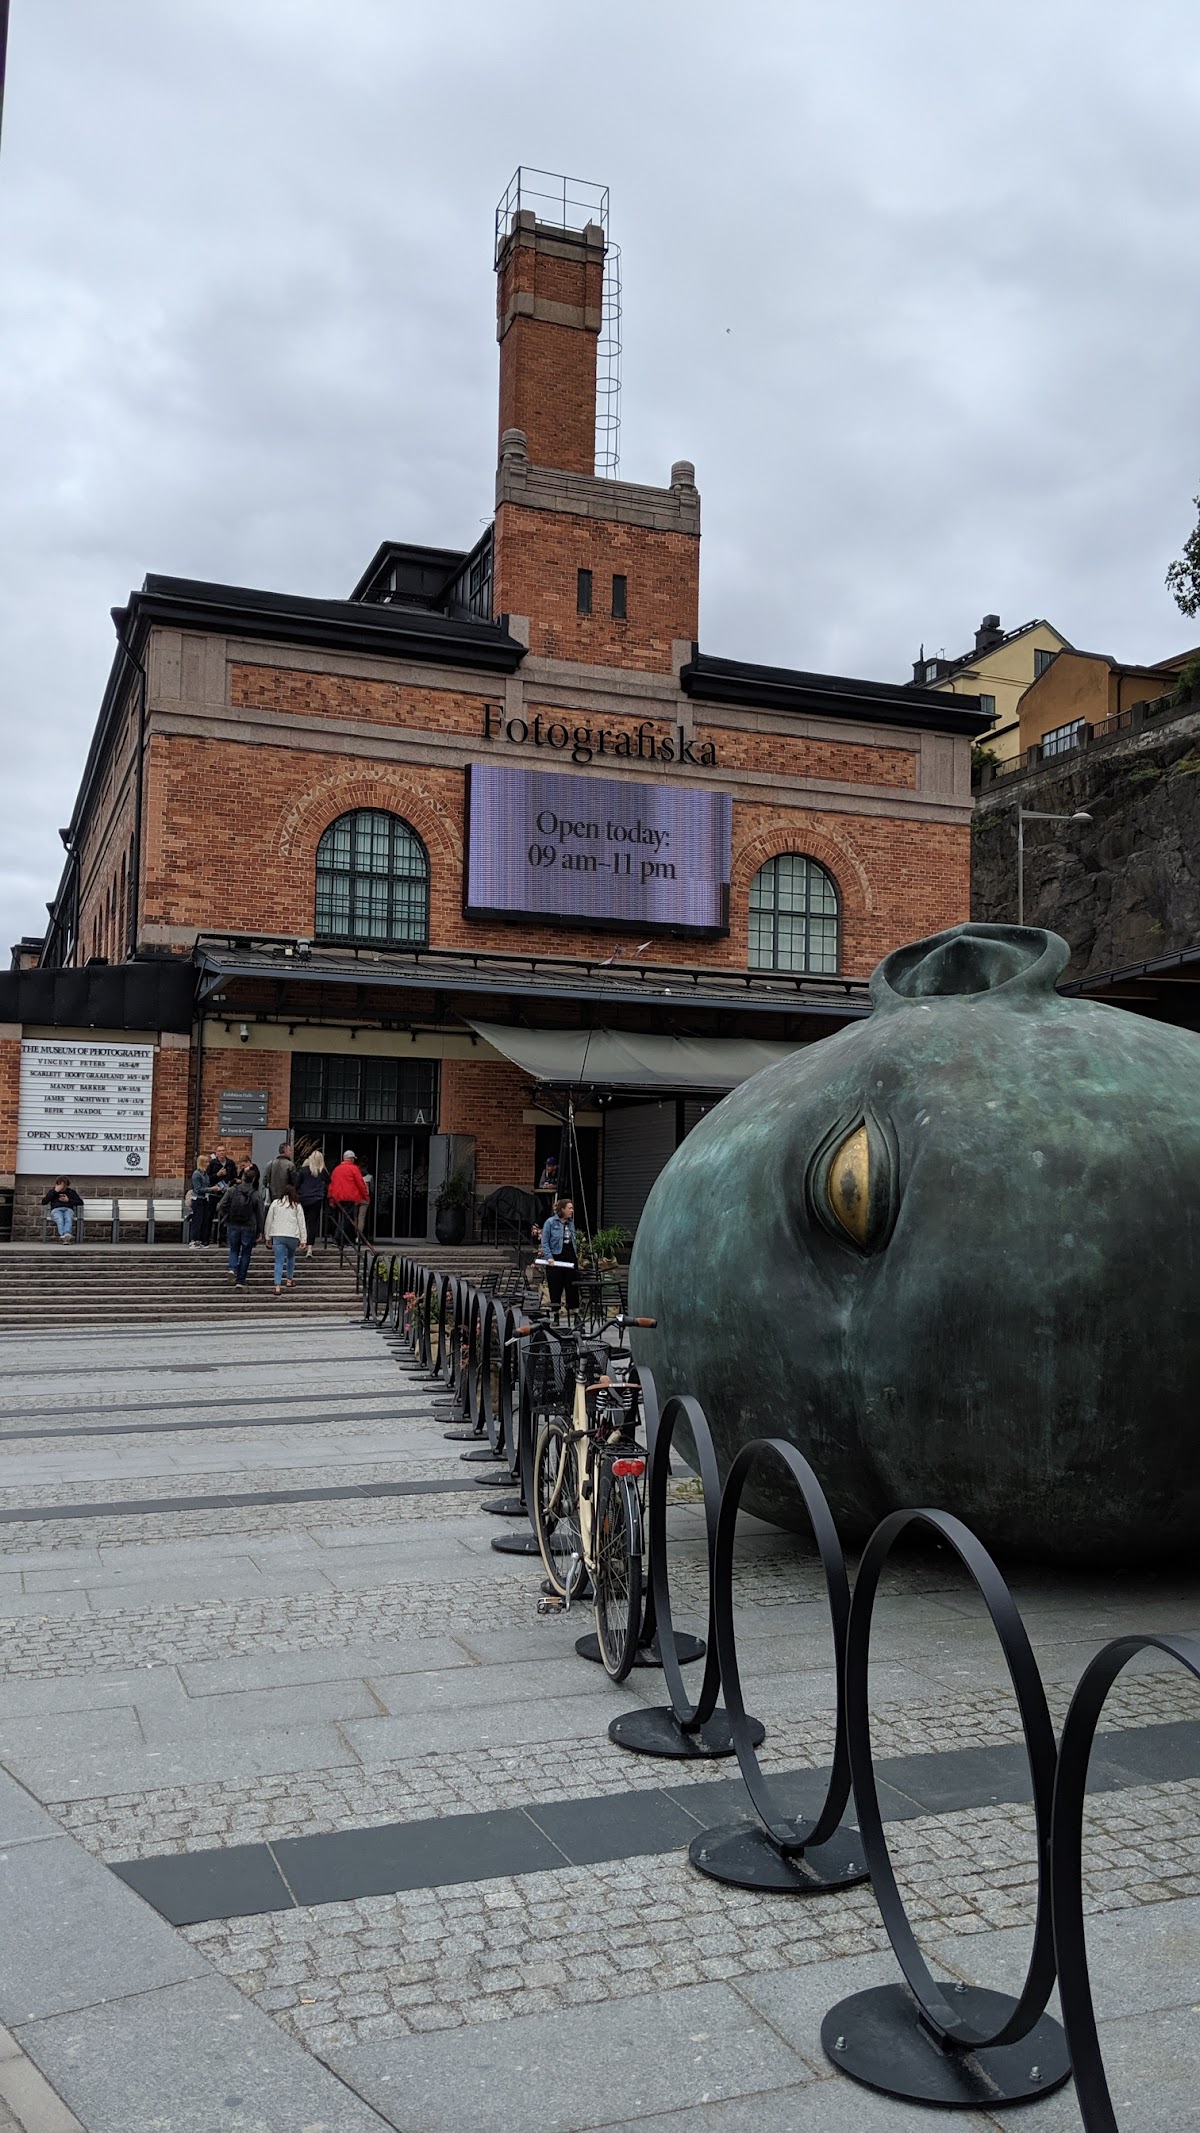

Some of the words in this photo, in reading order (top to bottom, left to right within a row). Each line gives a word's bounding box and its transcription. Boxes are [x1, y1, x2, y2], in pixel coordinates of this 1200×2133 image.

[481, 703, 719, 766] Fotografiska
[536, 810, 599, 843] Open
[606, 820, 670, 853] today:
[528, 844, 556, 868] 09
[640, 861, 676, 884] pm
[22, 1045, 39, 1053] THE
[41, 1046, 76, 1055] MUSEUM
[77, 1047, 88, 1055] OF
[90, 1048, 150, 1058] PHOTOGRAPHY
[413, 1109, 427, 1124] A
[27, 1130, 51, 1139] OPEN
